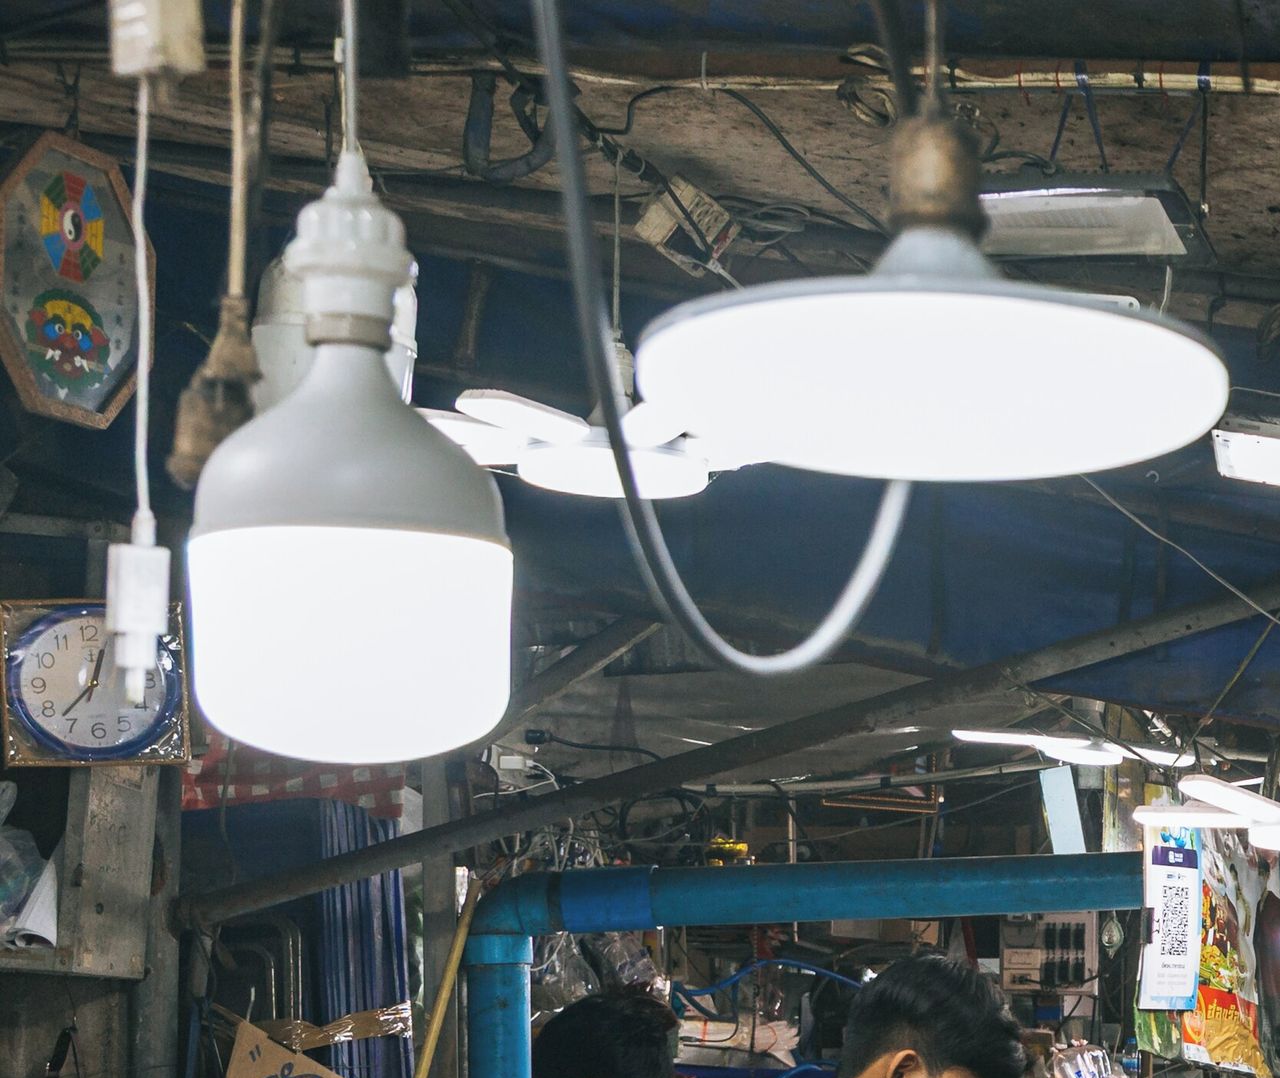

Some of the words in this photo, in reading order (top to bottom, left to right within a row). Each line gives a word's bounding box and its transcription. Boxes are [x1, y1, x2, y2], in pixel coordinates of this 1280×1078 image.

[79, 624, 99, 642] 12
[54, 634, 69, 651] 11
[33, 652, 55, 669] 10
[31, 677, 46, 694] 9
[41, 700, 56, 718] 8
[65, 718, 78, 734] 7
[91, 722, 107, 739] 6
[117, 716, 131, 733] 5
